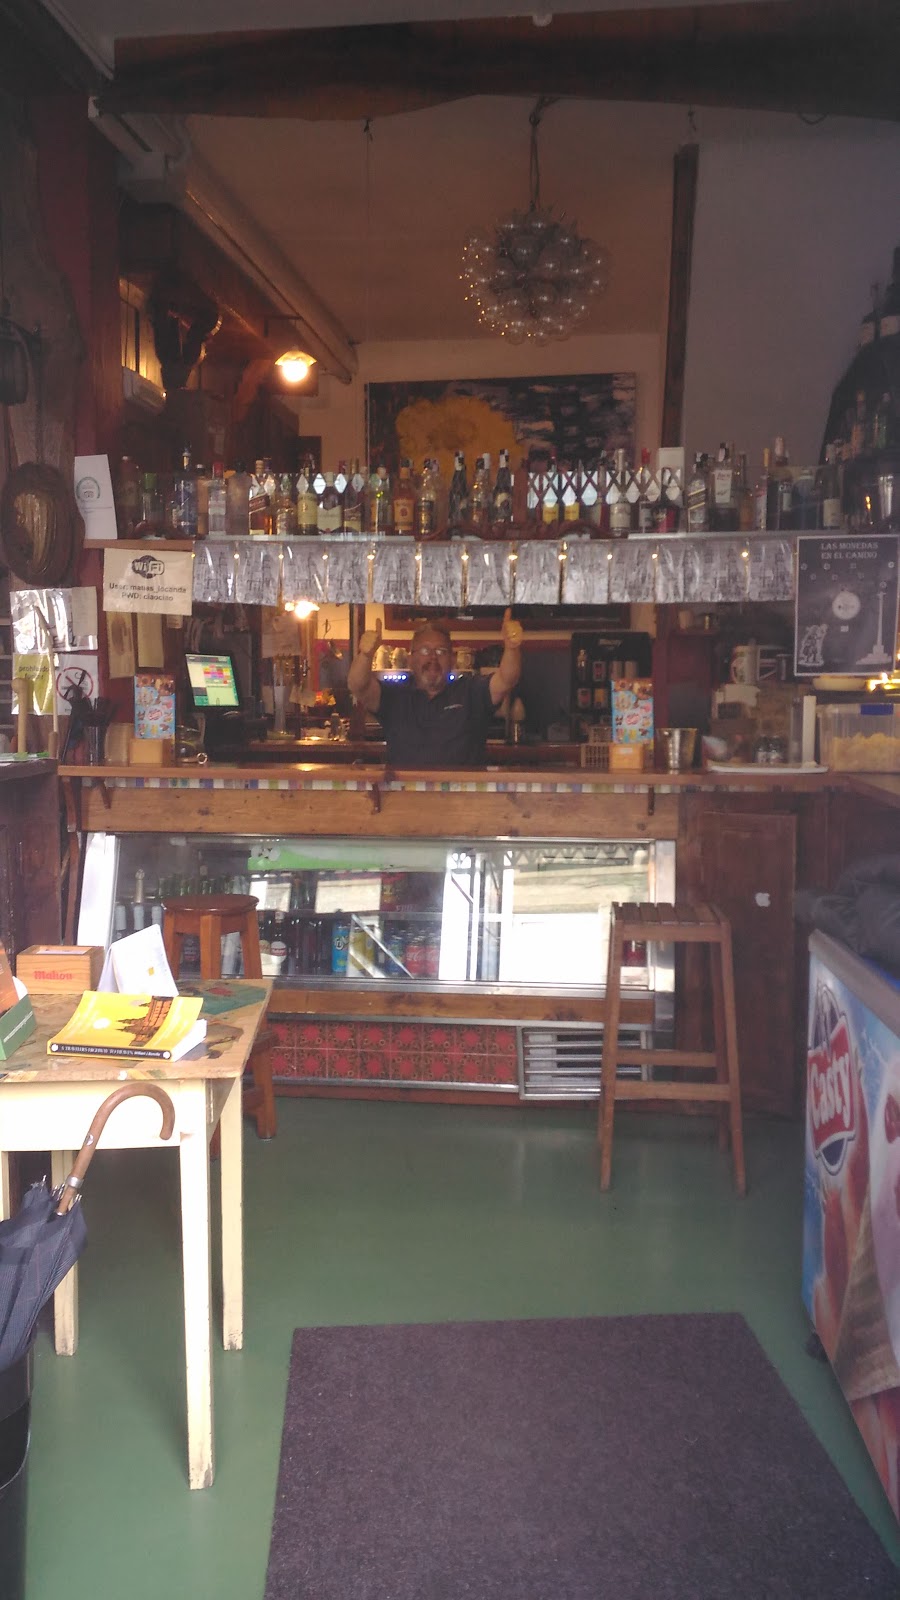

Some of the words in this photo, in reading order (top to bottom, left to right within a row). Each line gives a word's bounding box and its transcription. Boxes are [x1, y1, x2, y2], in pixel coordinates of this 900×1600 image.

[821, 542, 838, 550] LAS
[839, 542, 879, 550] MONEDAS
[821, 551, 832, 560] EN
[833, 551, 843, 560] EL
[34, 970, 73, 980] Mahou
